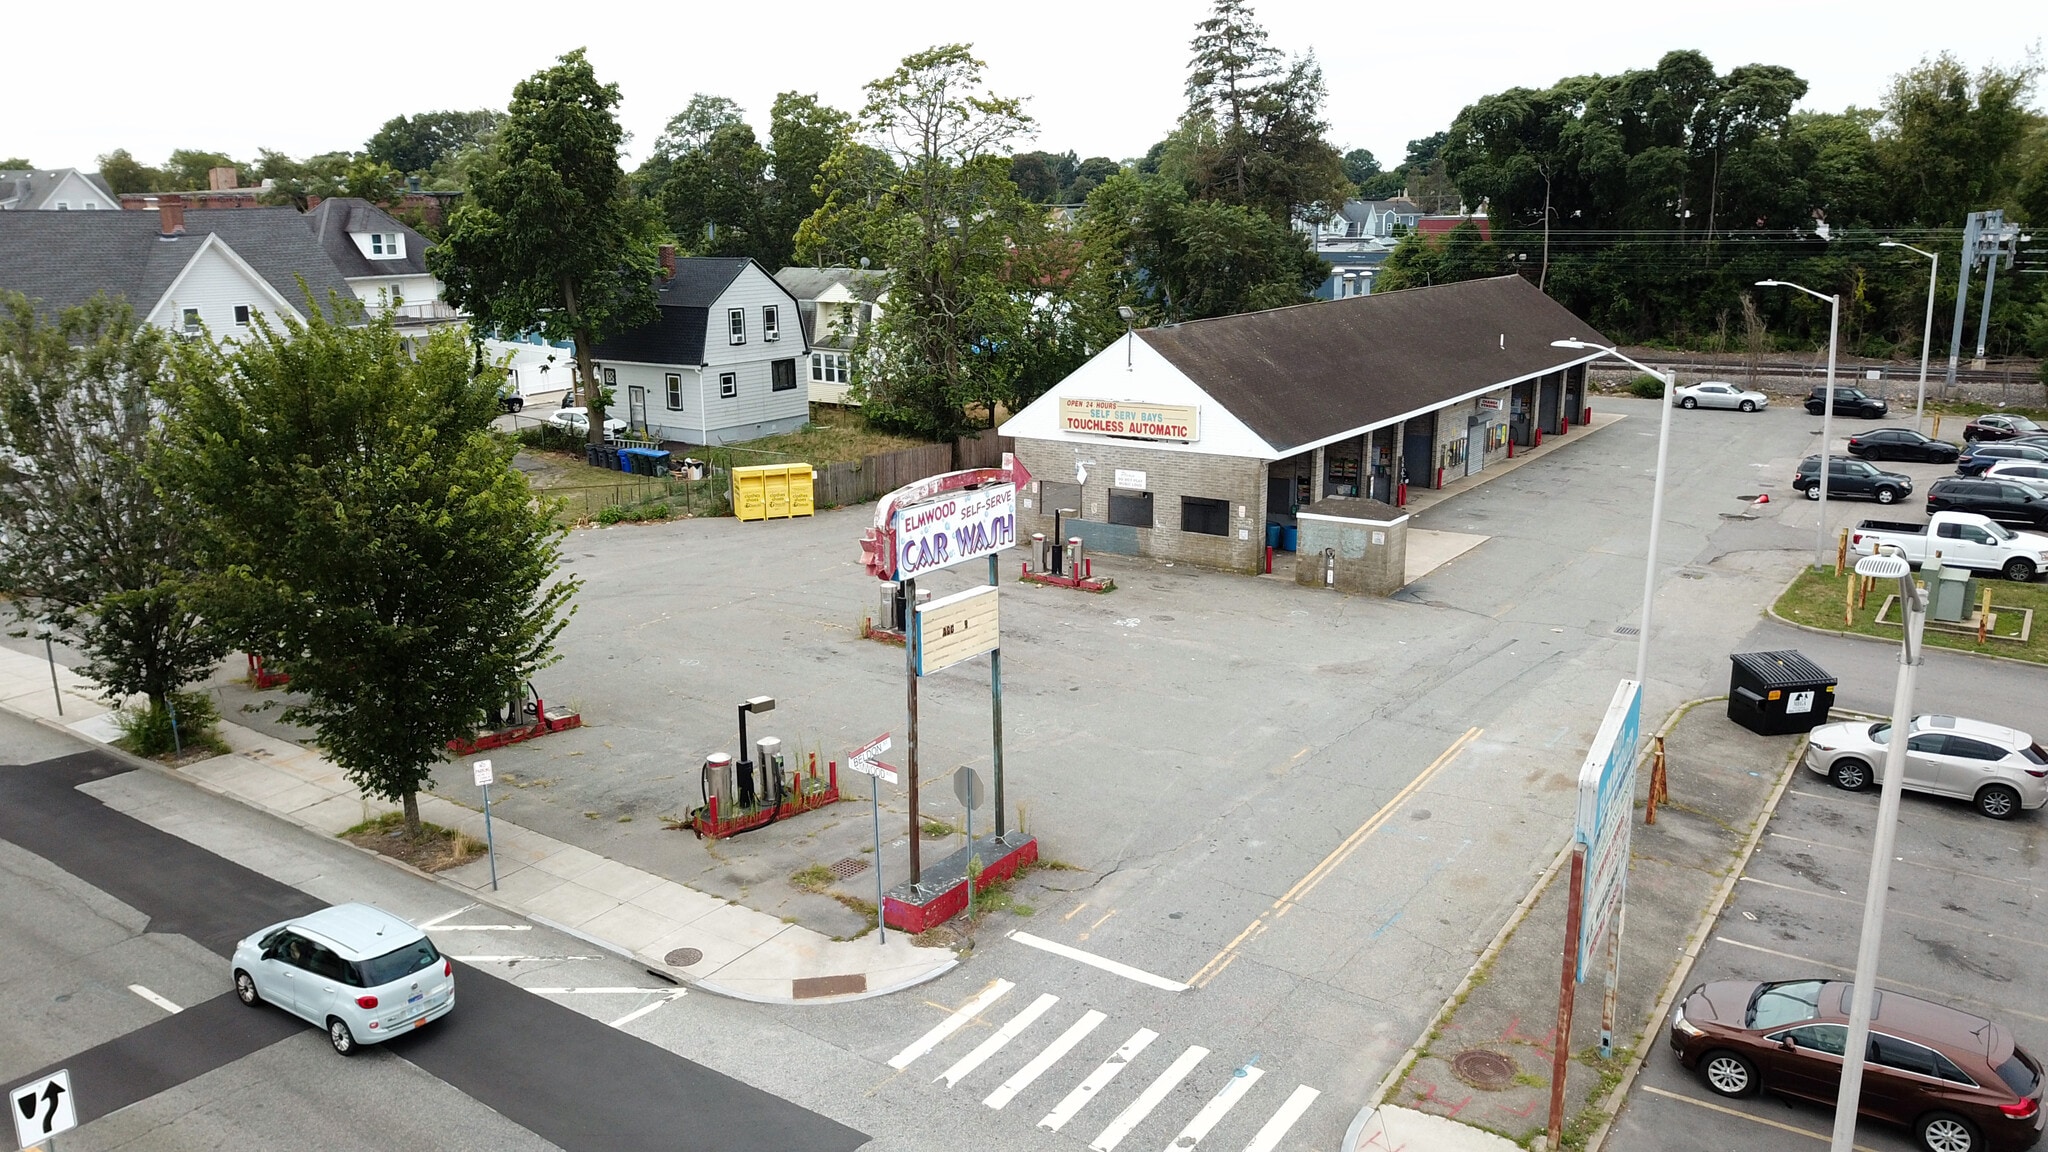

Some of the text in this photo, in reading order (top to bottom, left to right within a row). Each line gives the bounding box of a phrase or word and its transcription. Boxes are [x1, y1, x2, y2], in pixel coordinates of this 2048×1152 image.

[1066, 400, 1083, 408] OPEN
[1096, 402, 1117, 410] HOURS
[1090, 409, 1163, 423] SELF SERV BAYS
[1067, 418, 1188, 438] TOUCHLESS AUTOMATIC
[904, 490, 1012, 533] ELMWOOD SELF-SERVE
[902, 513, 1014, 573] CAR WASH
